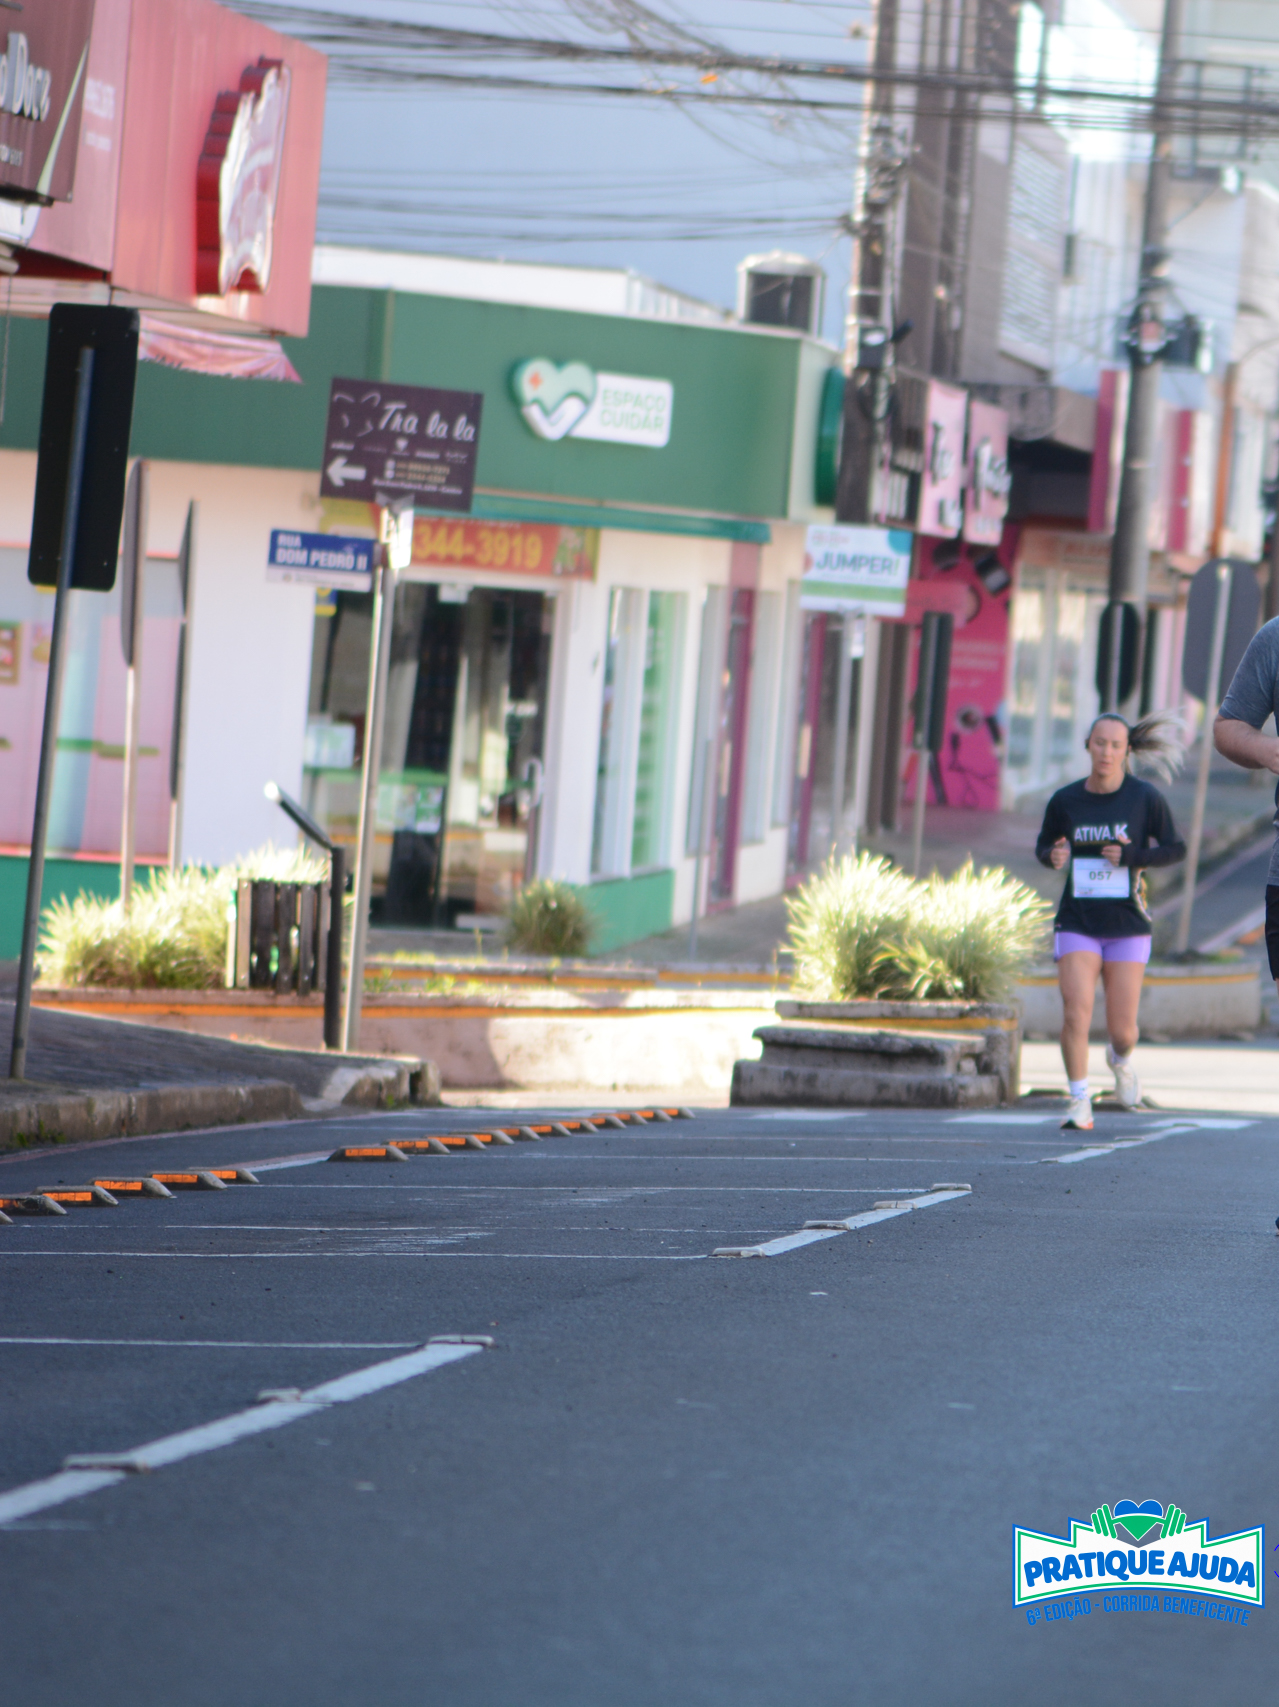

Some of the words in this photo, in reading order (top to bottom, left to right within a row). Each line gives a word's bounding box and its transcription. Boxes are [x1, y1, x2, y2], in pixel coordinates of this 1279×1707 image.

[378, 401, 419, 435] Tra
[426, 411, 448, 439] la
[453, 414, 475, 442] la
[601, 409, 664, 433] CUIDAR
[277, 532, 302, 547] RUA
[412, 522, 543, 570] 344-3919
[276, 547, 308, 566] DOM
[310, 550, 355, 570] PEDRO
[356, 554, 368, 571] II
[815, 550, 900, 576] JUMPER!
[1089, 871, 1112, 881] 057
